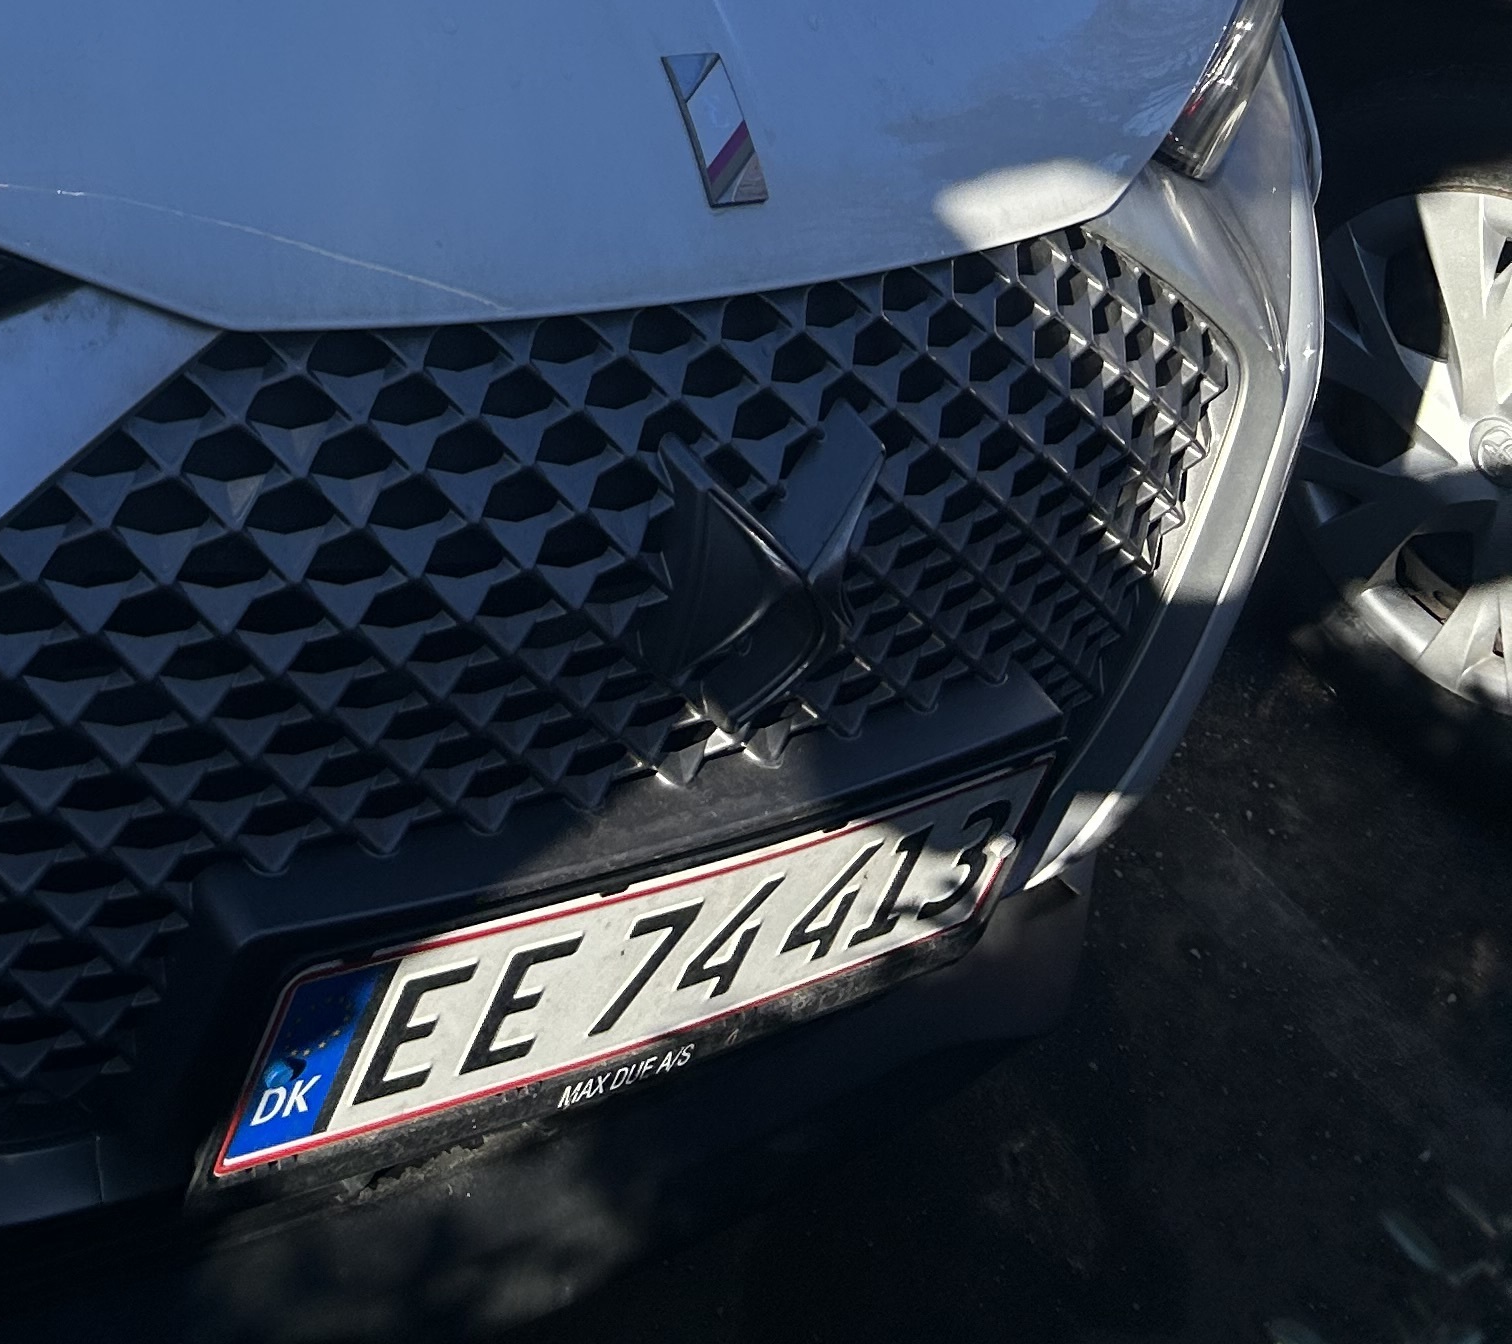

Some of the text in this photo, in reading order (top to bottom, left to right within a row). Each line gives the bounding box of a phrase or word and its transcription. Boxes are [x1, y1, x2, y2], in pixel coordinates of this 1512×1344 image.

[351, 799, 1012, 1106] EE 74 413
[250, 1075, 322, 1127] DK
[557, 1071, 612, 1109] MAX
[655, 1043, 695, 1075] A/S
